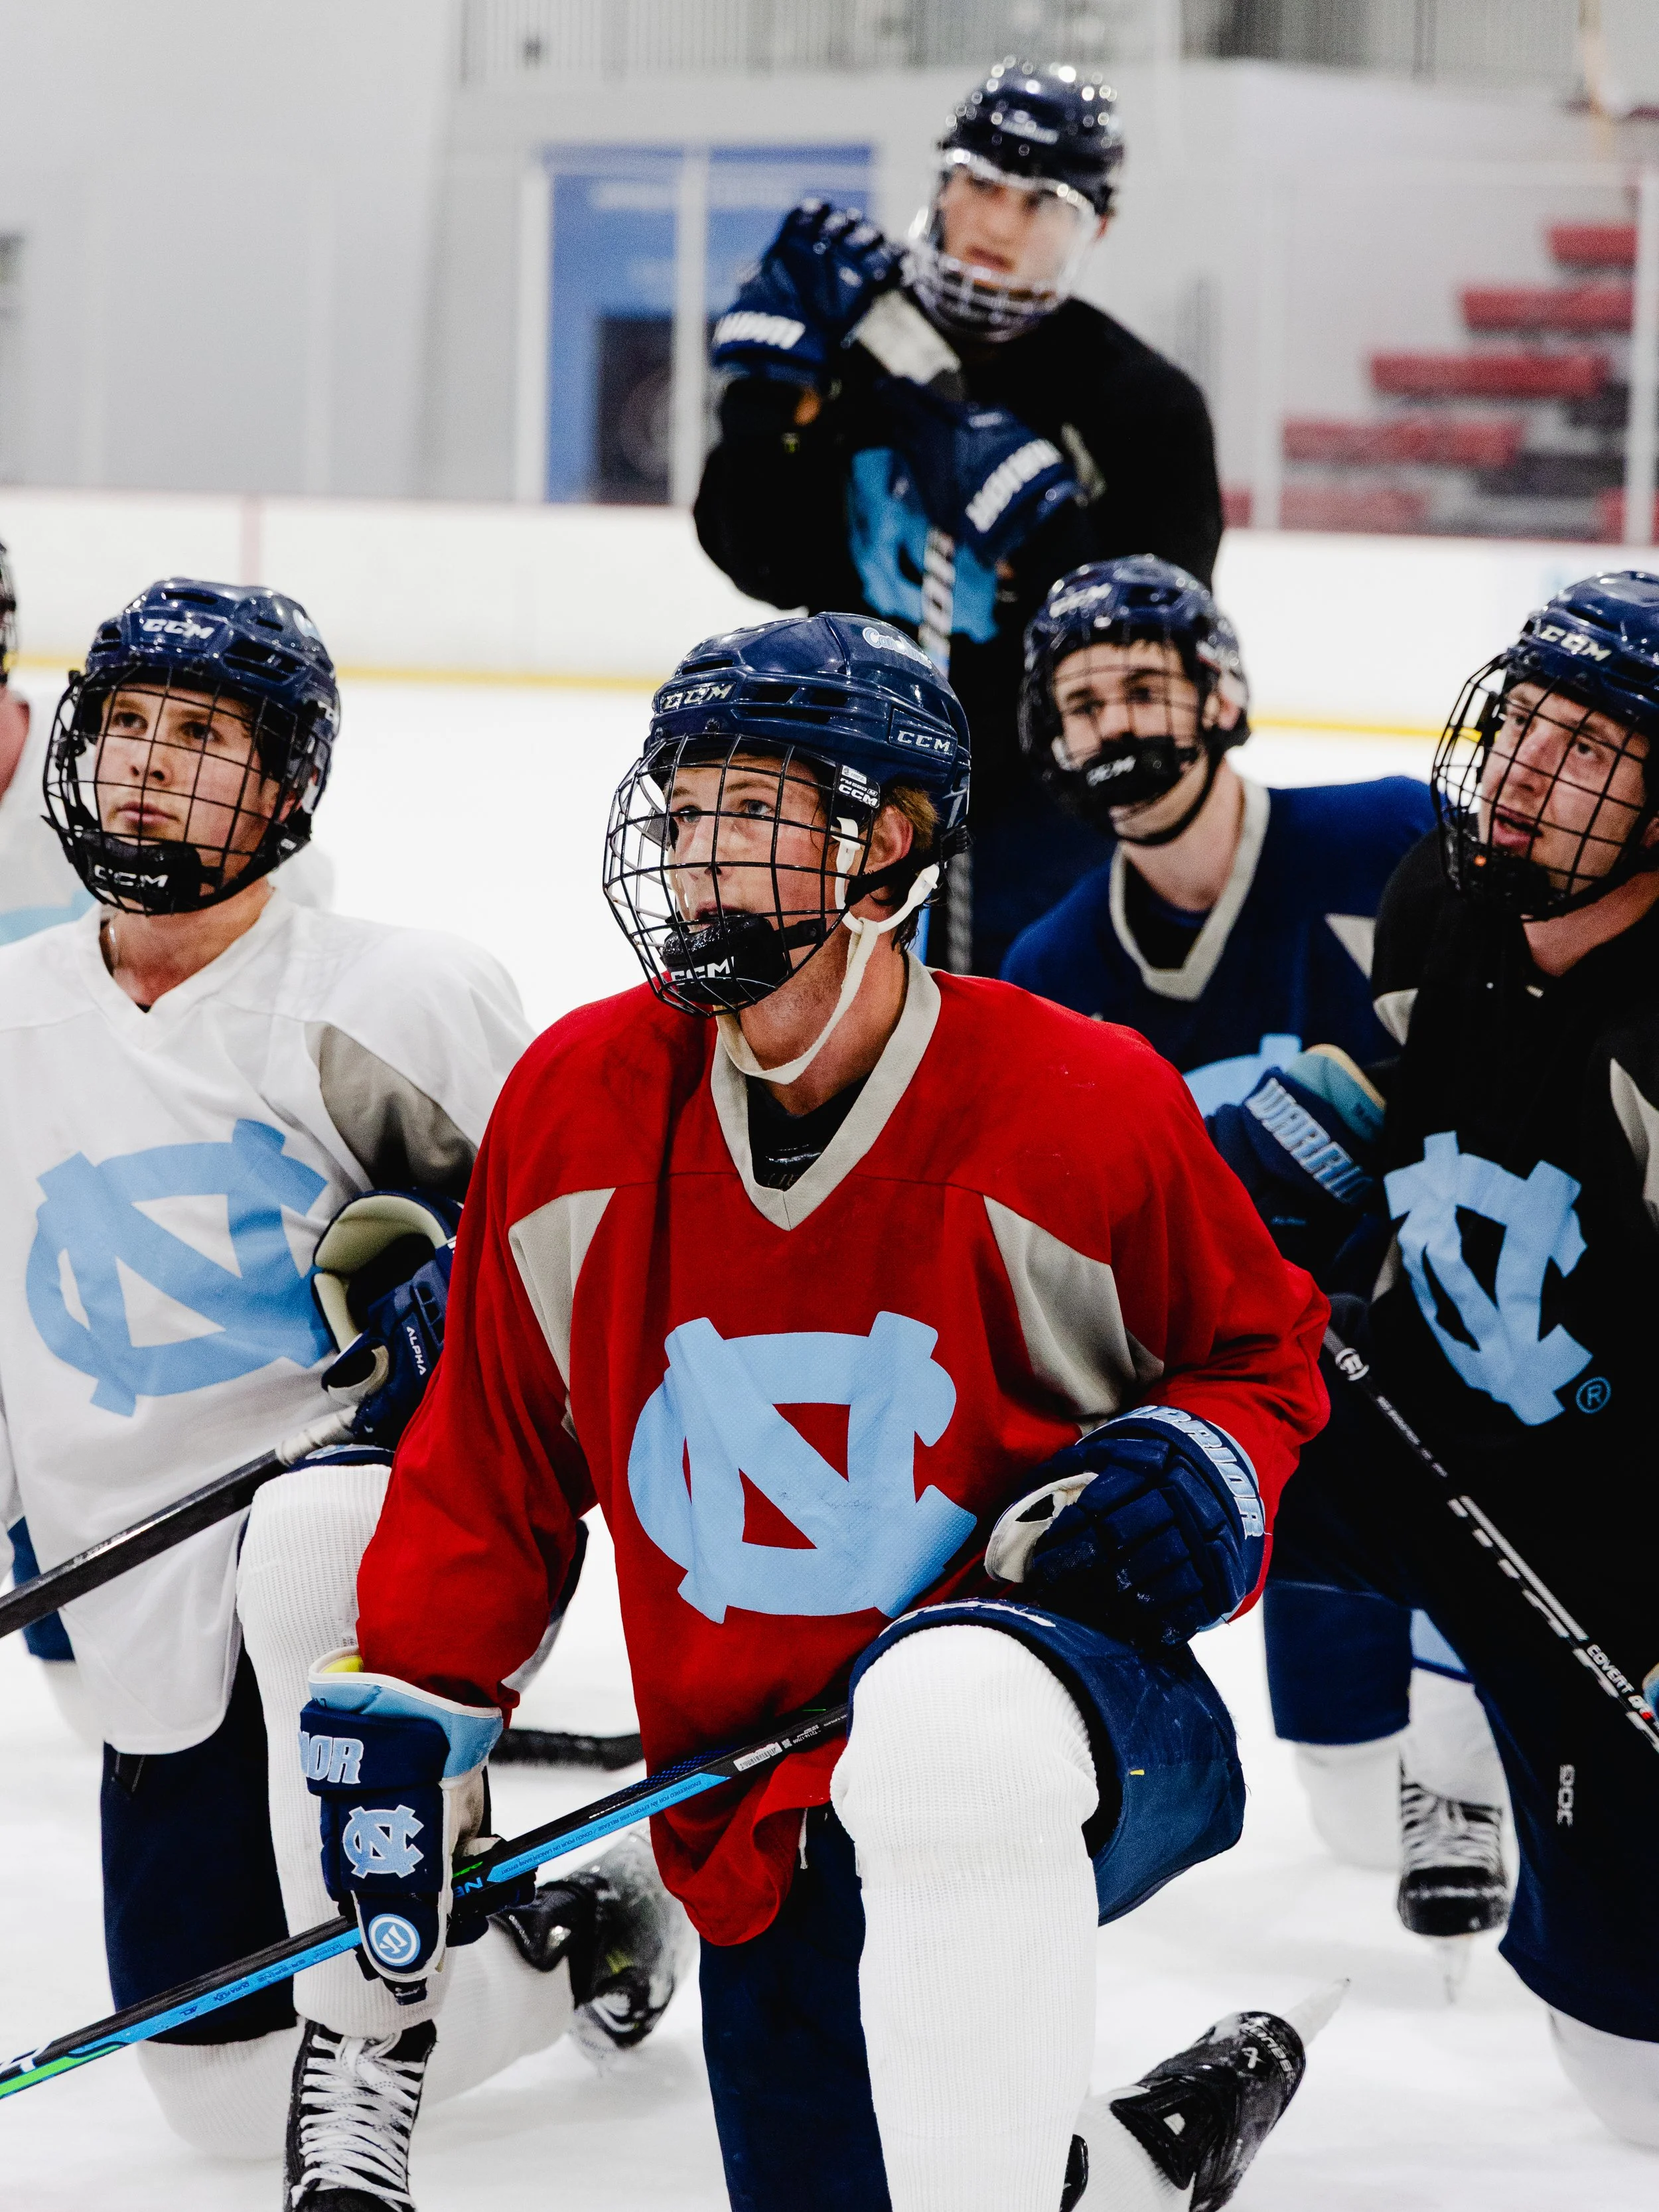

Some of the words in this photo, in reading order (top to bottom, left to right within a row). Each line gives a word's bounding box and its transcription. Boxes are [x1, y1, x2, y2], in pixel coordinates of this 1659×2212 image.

[662, 684, 733, 709] CCM
[897, 730, 950, 752] CCM
[839, 784, 878, 806] CCM
[94, 865, 169, 888] CCM
[670, 956, 735, 986] CCM
[406, 1326, 427, 1371] ALPHA
[1587, 1644, 1635, 1694] COVERT
[669, 1780, 701, 1798] ENGINEERED
[597, 1817, 620, 1830] RELEASE
[618, 1804, 650, 1821] EFFORTLESS
[532, 1848, 552, 1860] LANCER
[560, 1838, 575, 1848] POUR
